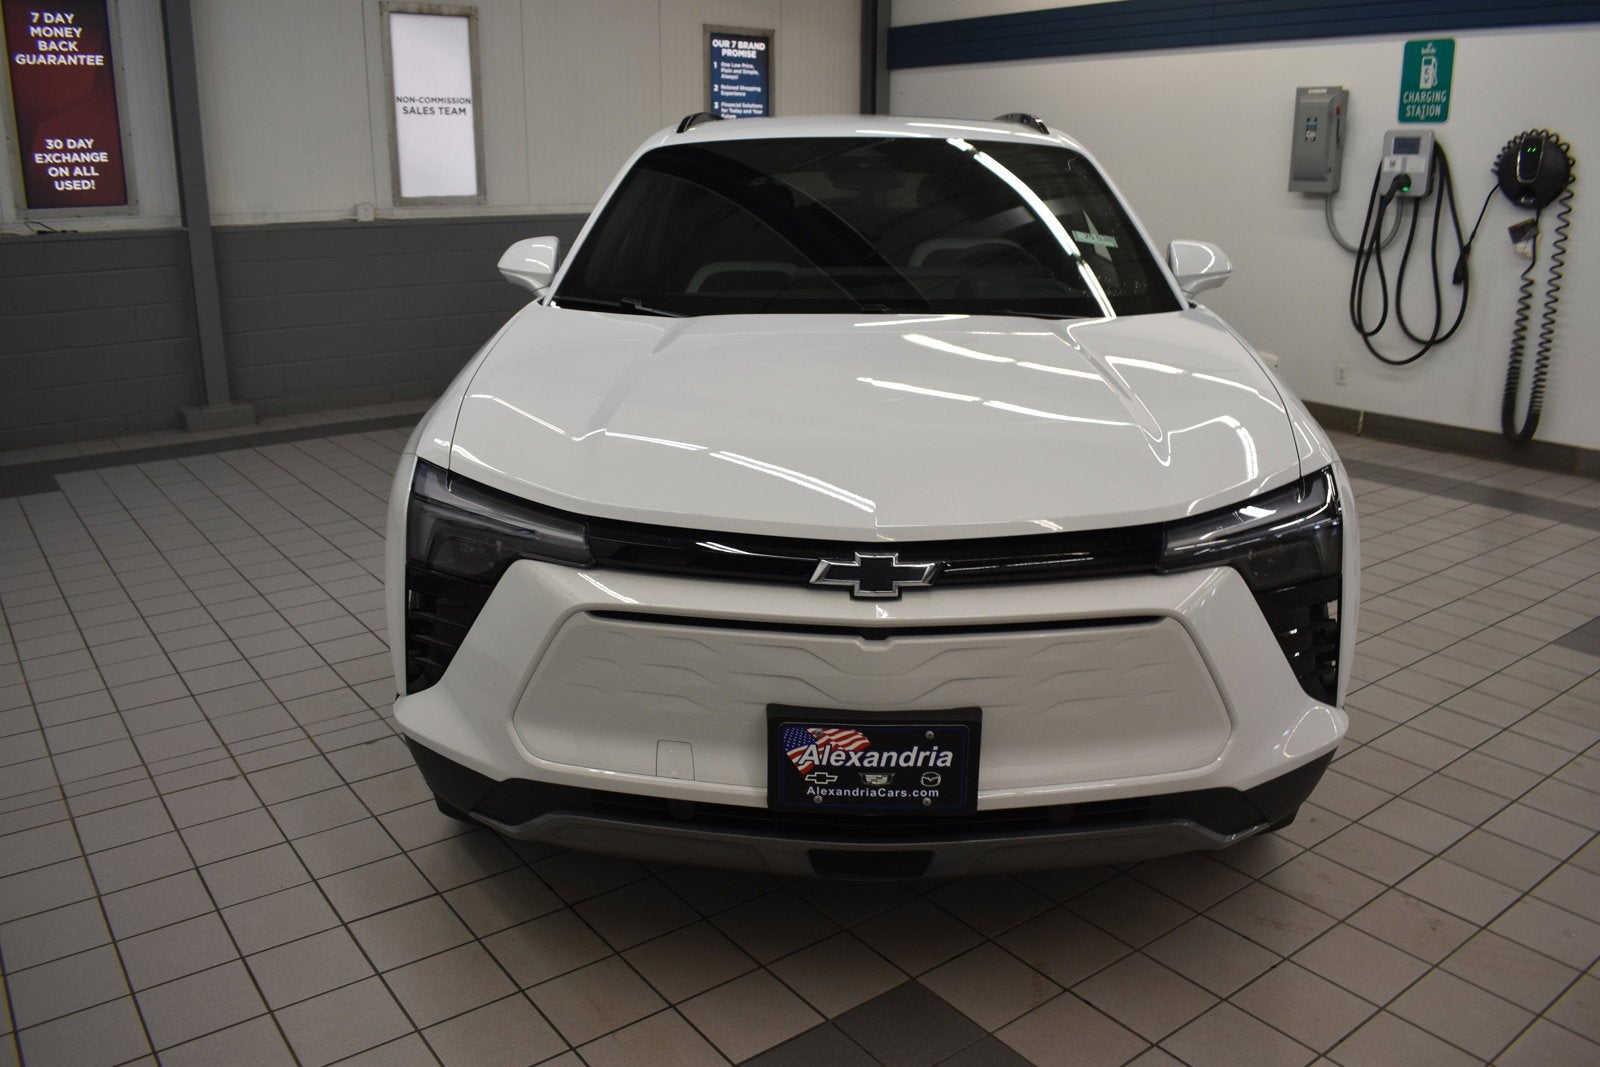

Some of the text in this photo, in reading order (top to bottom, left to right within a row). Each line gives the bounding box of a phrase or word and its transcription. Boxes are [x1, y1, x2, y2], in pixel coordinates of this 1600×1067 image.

[30, 12, 75, 24] 7 DAY
[30, 26, 83, 38] MONEY
[37, 40, 79, 52] BACK
[712, 39, 766, 51] OUR 7 BRAND
[721, 48, 757, 59] PROMISE
[14, 54, 105, 66] GUARANTEE
[713, 61, 718, 69] 1
[713, 84, 719, 92] 2
[396, 96, 471, 104] NON-COMMISSION
[1403, 90, 1448, 104] CHARGING
[402, 106, 467, 115] SALES TEAM
[713, 101, 719, 109] 3
[1405, 104, 1442, 117] STATION
[45, 139, 94, 150] 30 DAY
[34, 152, 109, 164] EXCHANGE
[48, 166, 100, 177] ON ALL
[54, 179, 96, 191] USED!
[798, 743, 954, 767] Alexandria
[806, 786, 939, 798] AlexandriaCars.com
